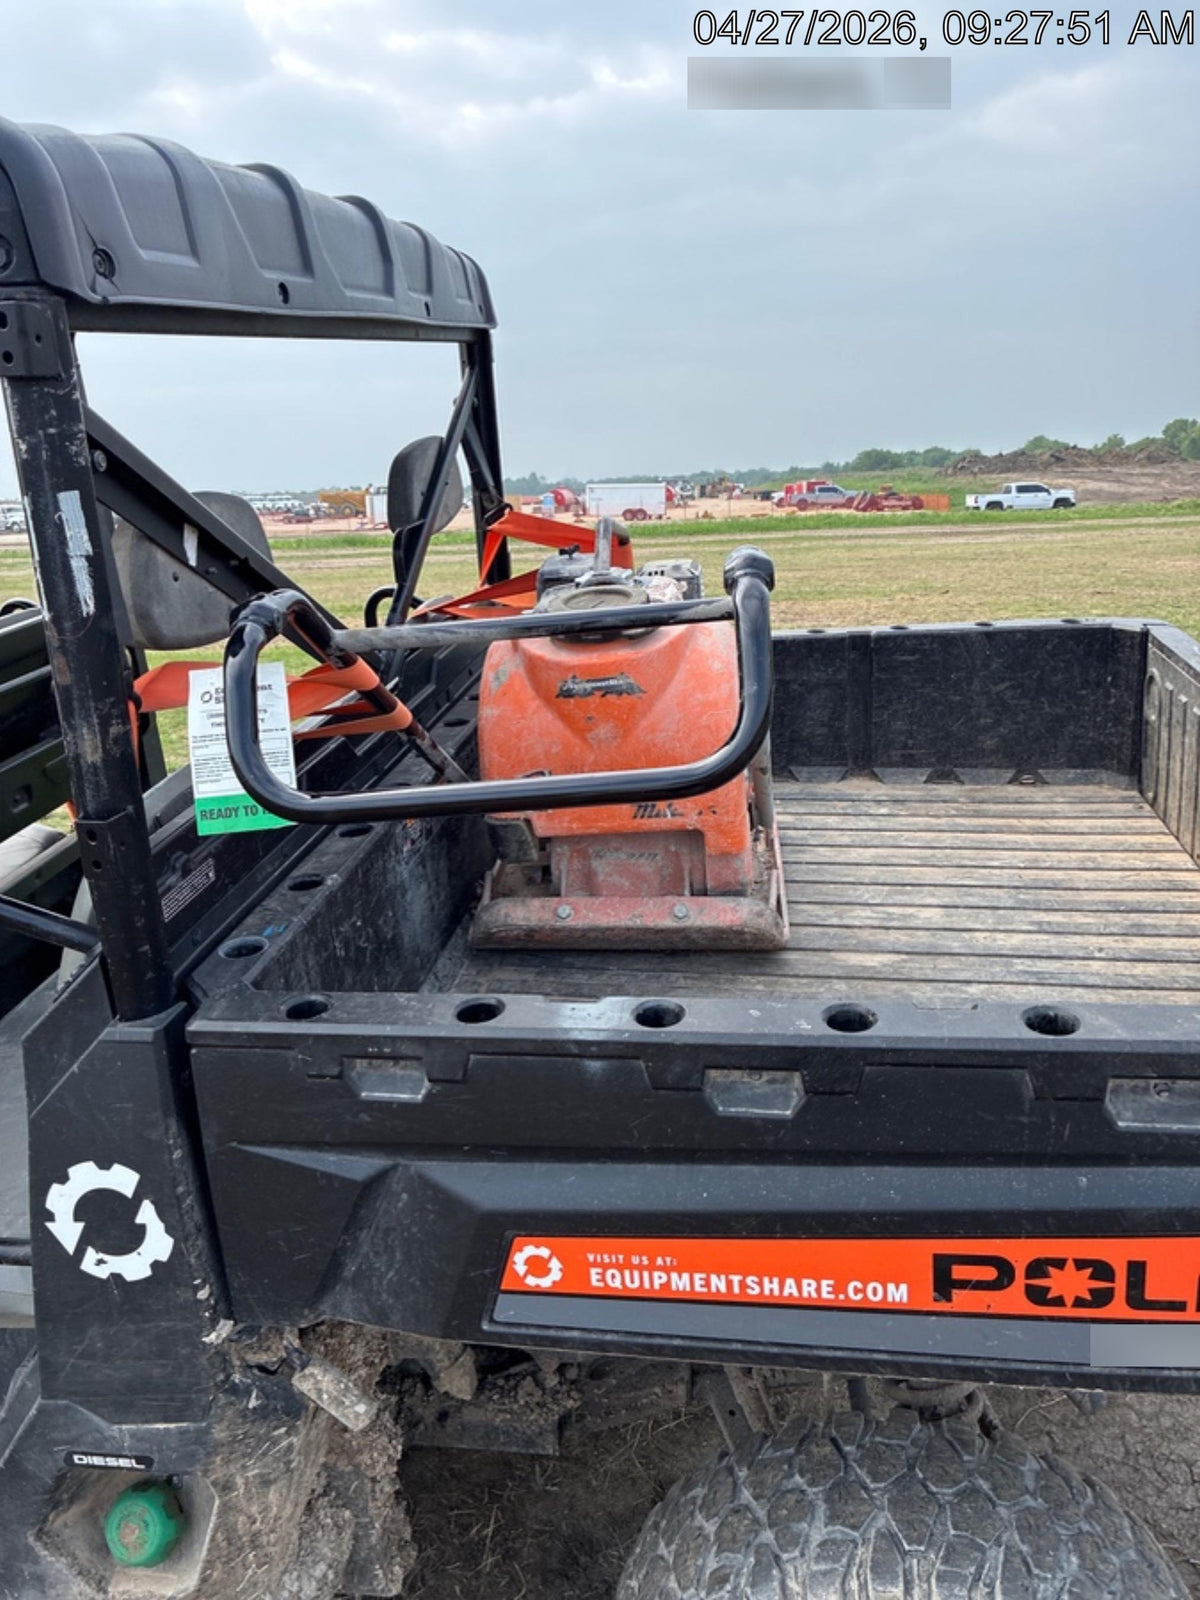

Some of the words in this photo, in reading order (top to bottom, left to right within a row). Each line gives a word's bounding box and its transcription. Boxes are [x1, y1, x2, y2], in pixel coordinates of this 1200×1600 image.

[200, 806, 240, 821] READY
[243, 804, 258, 817] TO
[586, 1252, 625, 1265] VISIT
[631, 1255, 650, 1266] US
[656, 1256, 678, 1267] AT:
[589, 1267, 909, 1304] EQUIPMENTSHARE.COM
[933, 1253, 1200, 1312] POL
[72, 1454, 146, 1469] DIESEL
